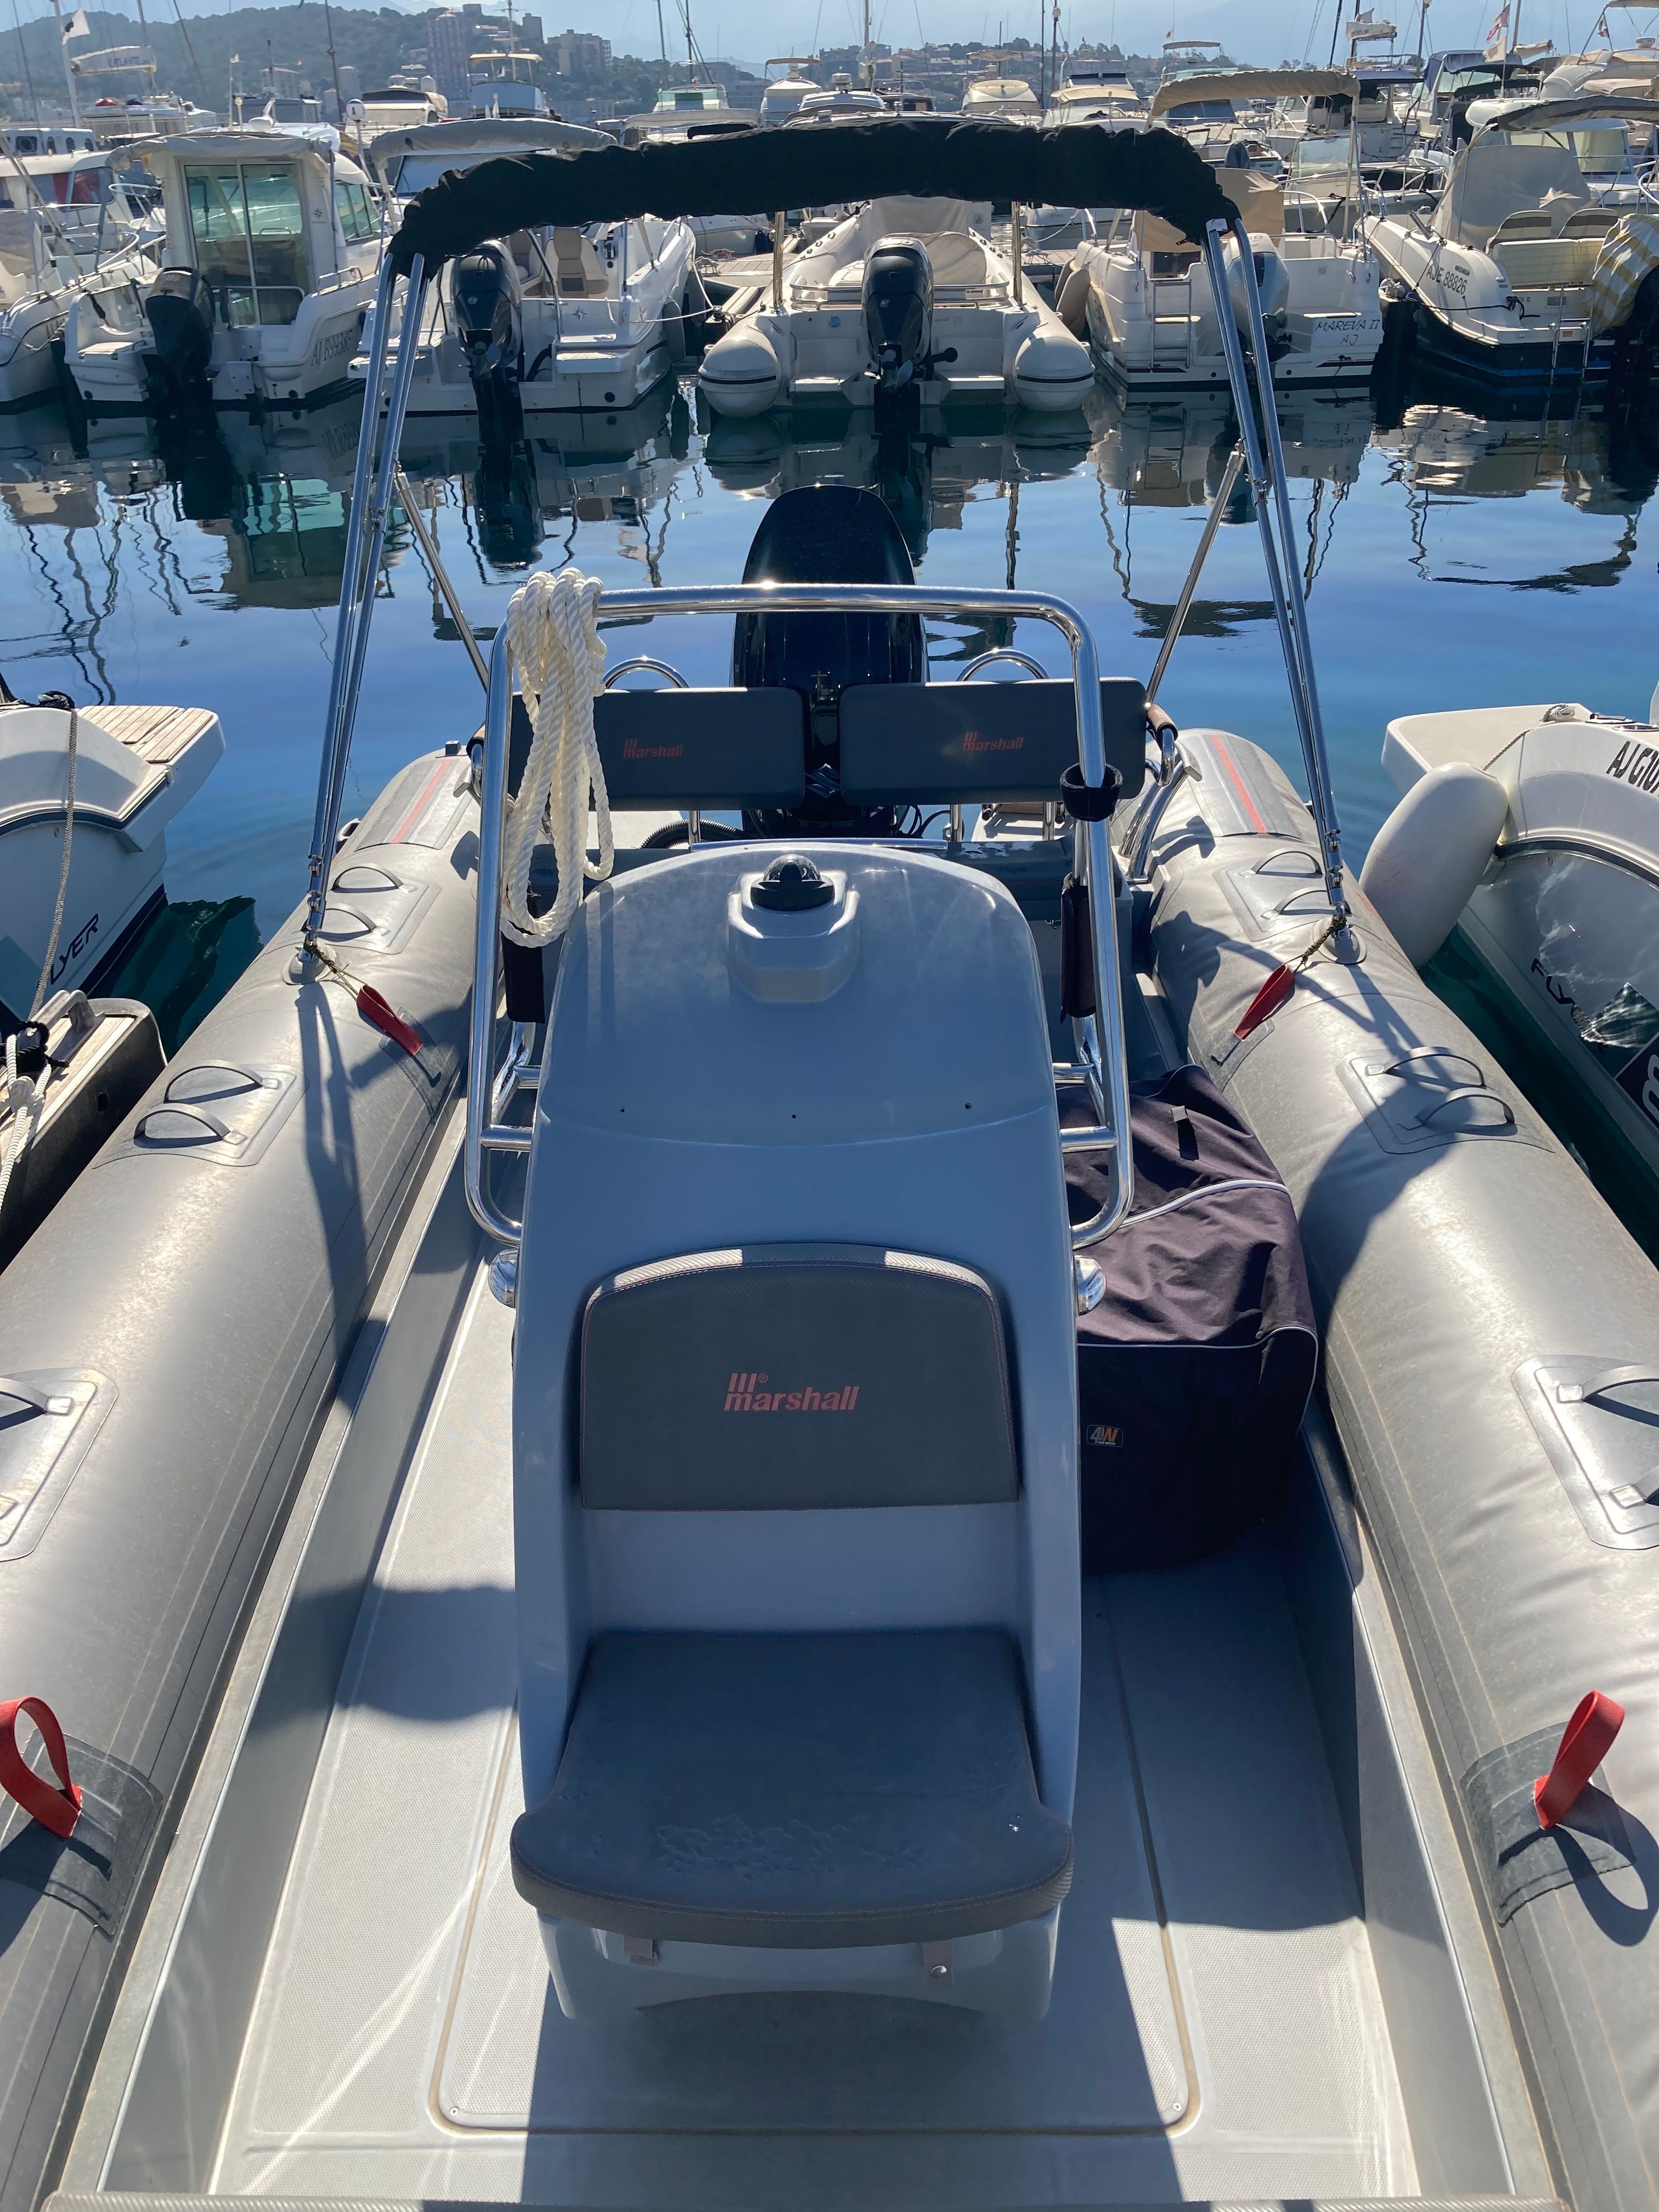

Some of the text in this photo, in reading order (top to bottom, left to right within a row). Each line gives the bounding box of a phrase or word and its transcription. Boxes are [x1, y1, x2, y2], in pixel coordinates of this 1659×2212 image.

[1443, 271, 1468, 295] 88826
[1315, 319, 1380, 332] MAREVA II
[1340, 335, 1358, 345] AJ
[623, 743, 683, 758] marshall
[963, 735, 1024, 752] marshall
[40, 913, 99, 988] LYER
[724, 1384, 860, 1411] marshall
